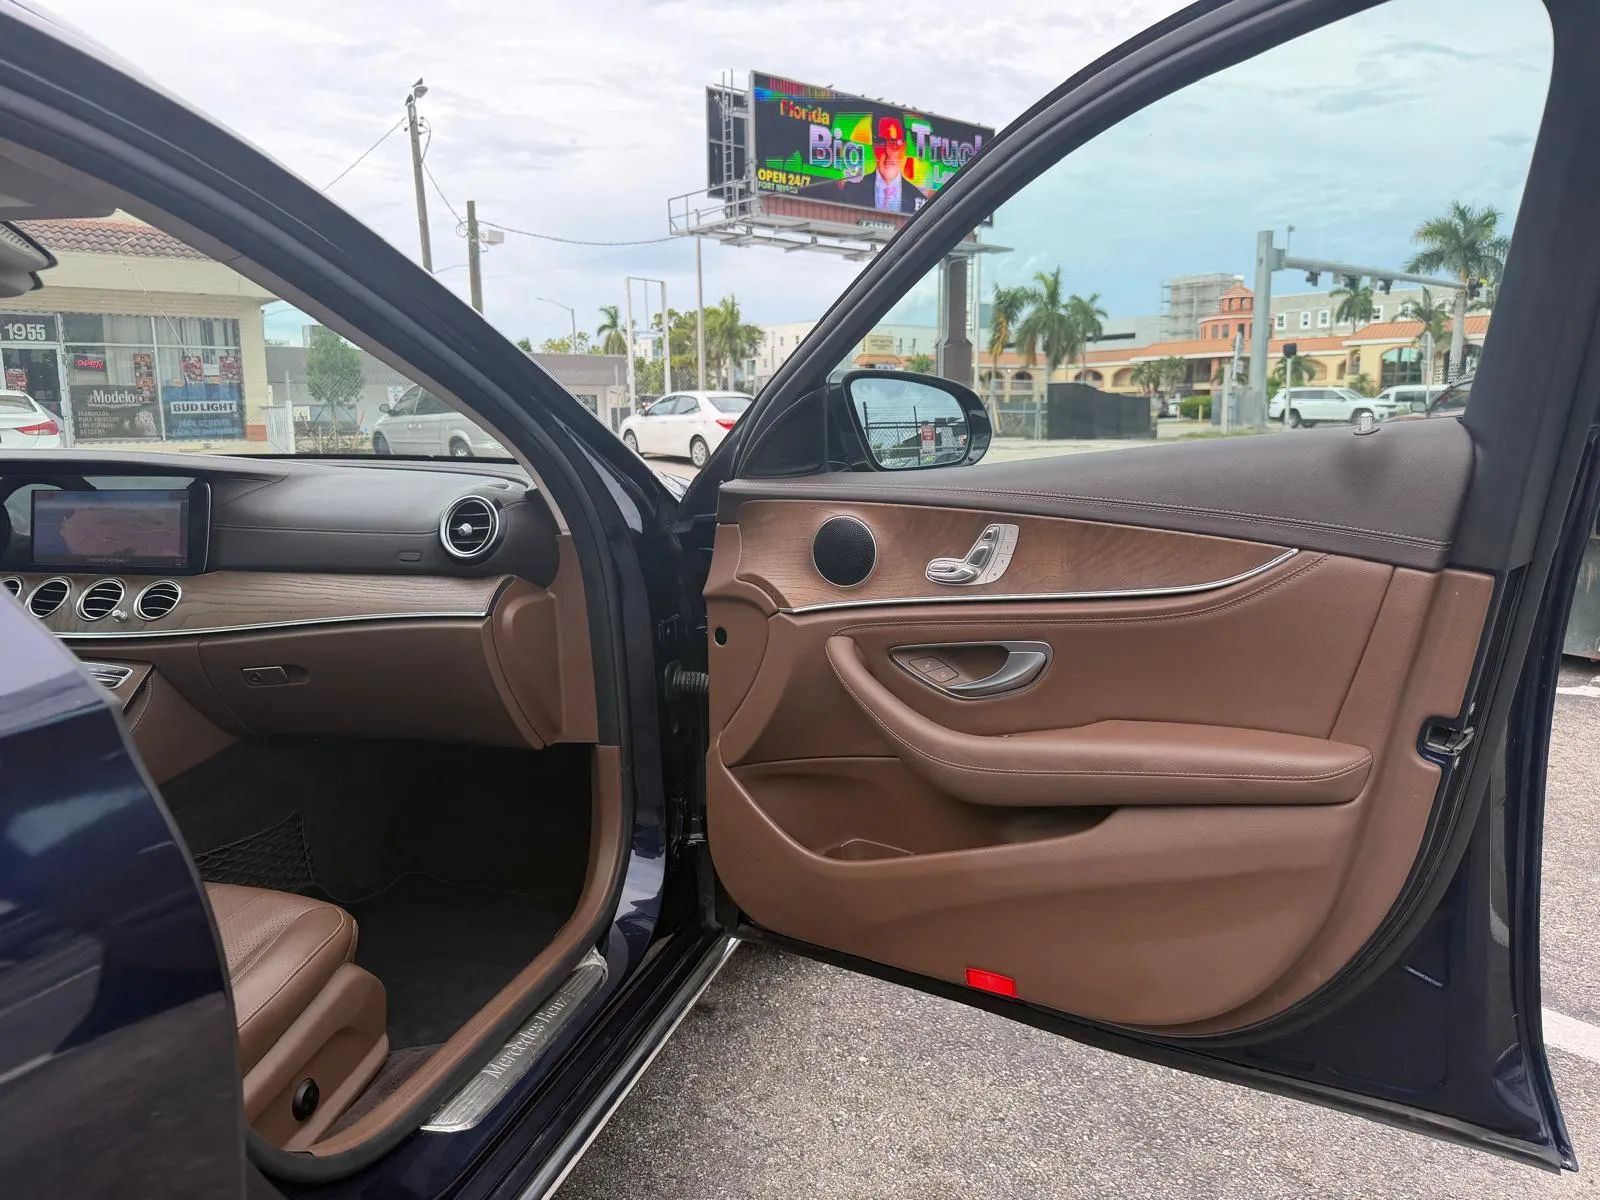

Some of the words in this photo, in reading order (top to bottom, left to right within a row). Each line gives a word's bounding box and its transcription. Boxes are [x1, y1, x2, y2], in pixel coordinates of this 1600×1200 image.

[780, 99, 830, 125] Florida
[809, 123, 865, 183] Big
[757, 168, 787, 184] OPEN
[788, 173, 811, 188] 24/7
[4, 323, 46, 341] 1955
[76, 359, 104, 369] OPEN
[93, 390, 135, 404] Modelo
[173, 403, 200, 412] BUD
[200, 402, 234, 411] LIGHT
